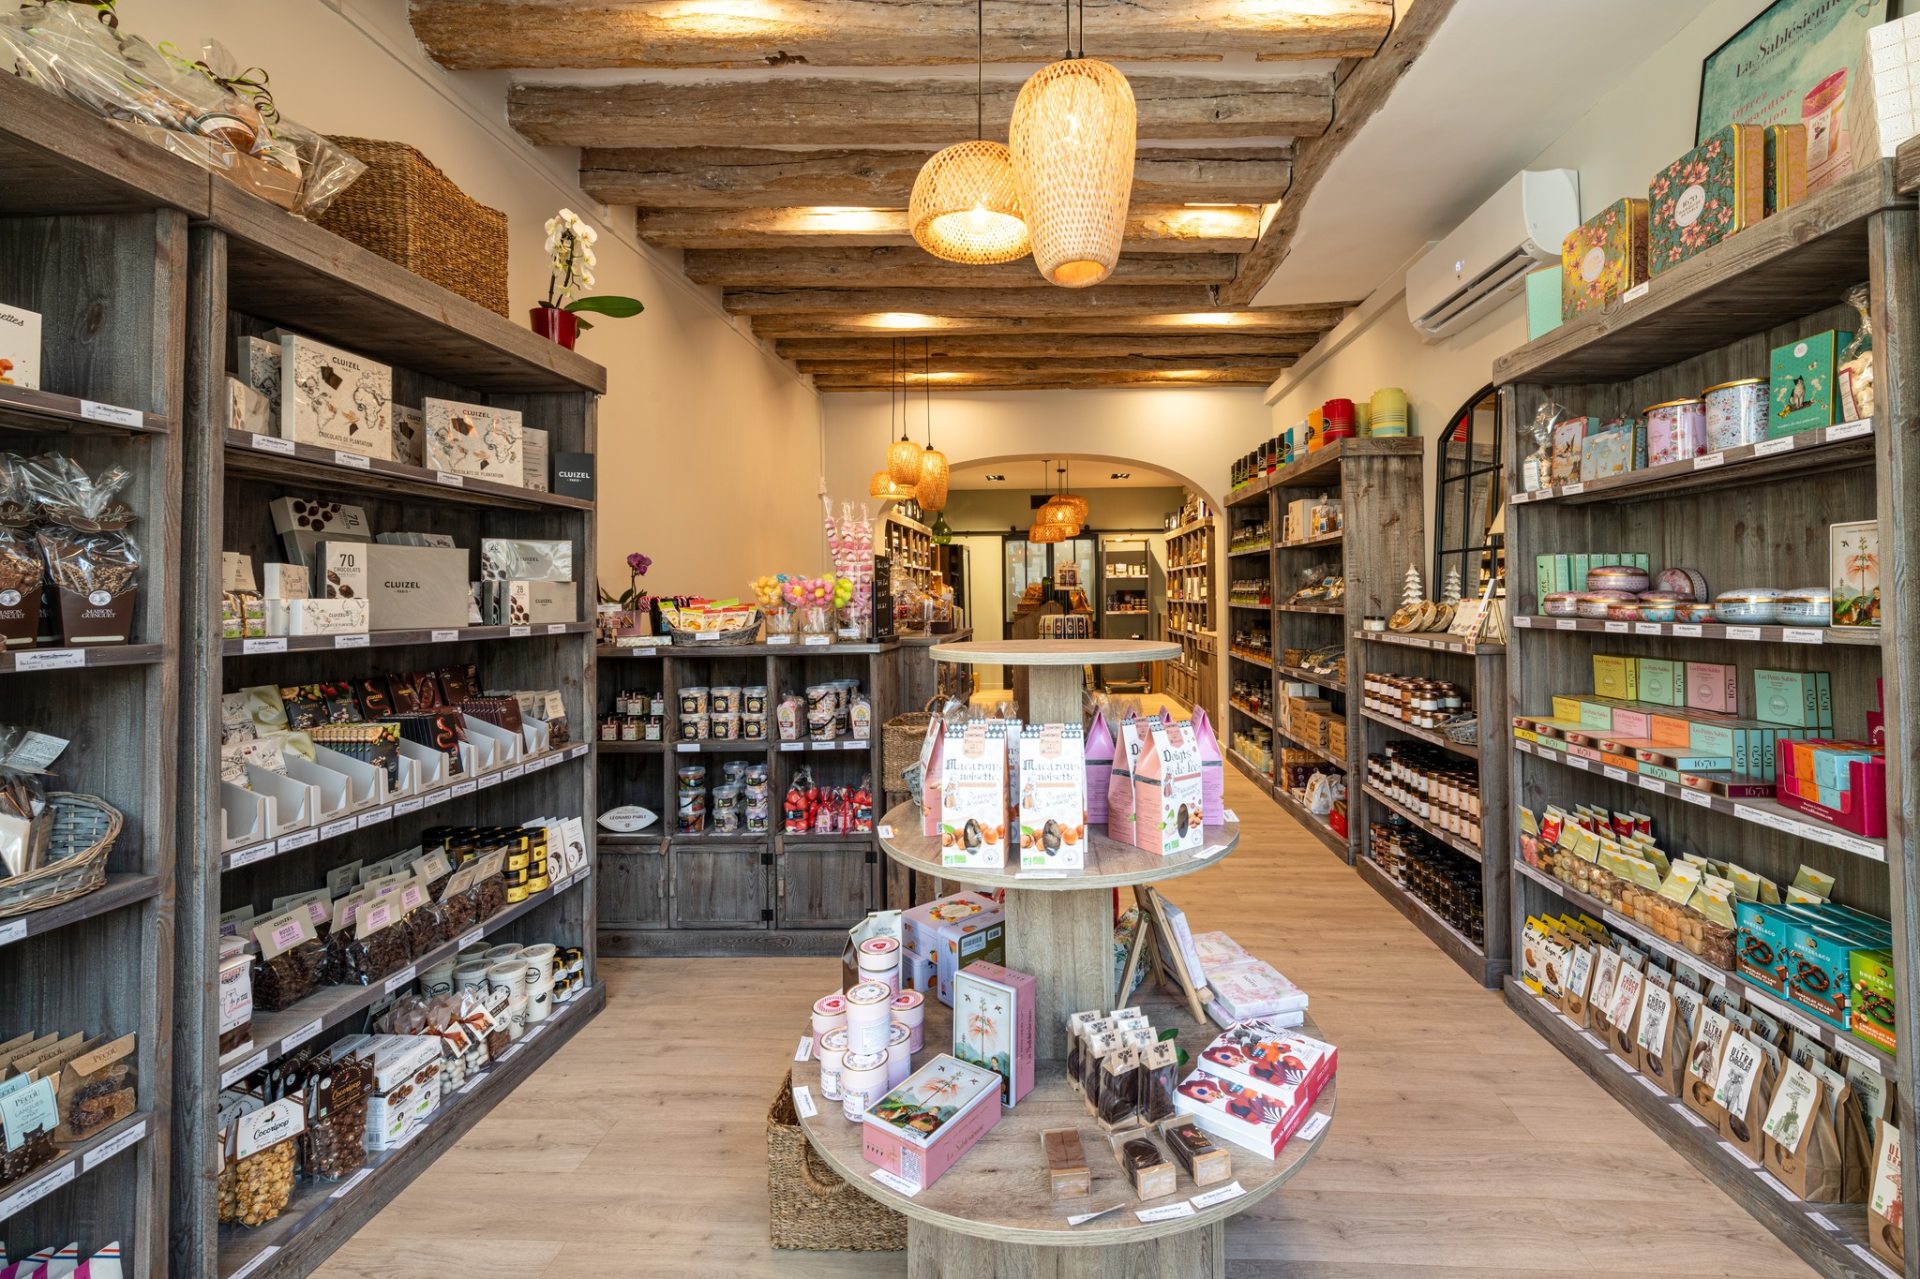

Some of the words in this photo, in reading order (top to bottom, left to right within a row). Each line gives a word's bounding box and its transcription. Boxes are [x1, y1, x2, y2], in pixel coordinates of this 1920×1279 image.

[332, 356, 361, 371] CLUIZEL
[407, 413, 422, 422] CLUIZ
[462, 409, 490, 419] CLUIZEL
[318, 430, 342, 444] CHOCOLATS
[558, 471, 590, 479] CLUIZEL
[348, 514, 360, 526] 70
[339, 553, 355, 568] 70
[384, 581, 420, 589] CLUIZEL
[516, 585, 524, 594] 28
[1806, 689, 1815, 711] 1670
[1821, 688, 1830, 711] 1670
[1163, 749, 1192, 763] Doigts
[1576, 747, 1591, 757] 1670
[1736, 745, 1746, 768] 1670
[1752, 745, 1761, 768] 1670
[1764, 745, 1774, 768] 1670
[945, 759, 1002, 771] Macarons
[1023, 759, 1080, 771] Macarons
[1611, 756, 1627, 767] 1670
[1694, 759, 1717, 768] 1670
[222, 769, 239, 779] UIZEL
[1650, 766, 1667, 778] 1670
[1745, 786, 1769, 797] 1670
[273, 916, 293, 927] CLUIZEL
[279, 925, 294, 936] ROSES
[1524, 932, 1541, 946] Kignn
[1545, 944, 1562, 960] Kignn
[1794, 942, 1831, 962] BRETZEL&CO
[1623, 974, 1639, 989] CHOCO
[1647, 995, 1666, 1009] CHOCO
[1677, 996, 1696, 1011] CHOCO
[1704, 1022, 1723, 1037] ULTRA
[1703, 1030, 1721, 1045] NOISETTE
[1731, 1047, 1754, 1066] ULTRA
[1729, 1055, 1751, 1074] CHOCOLAT
